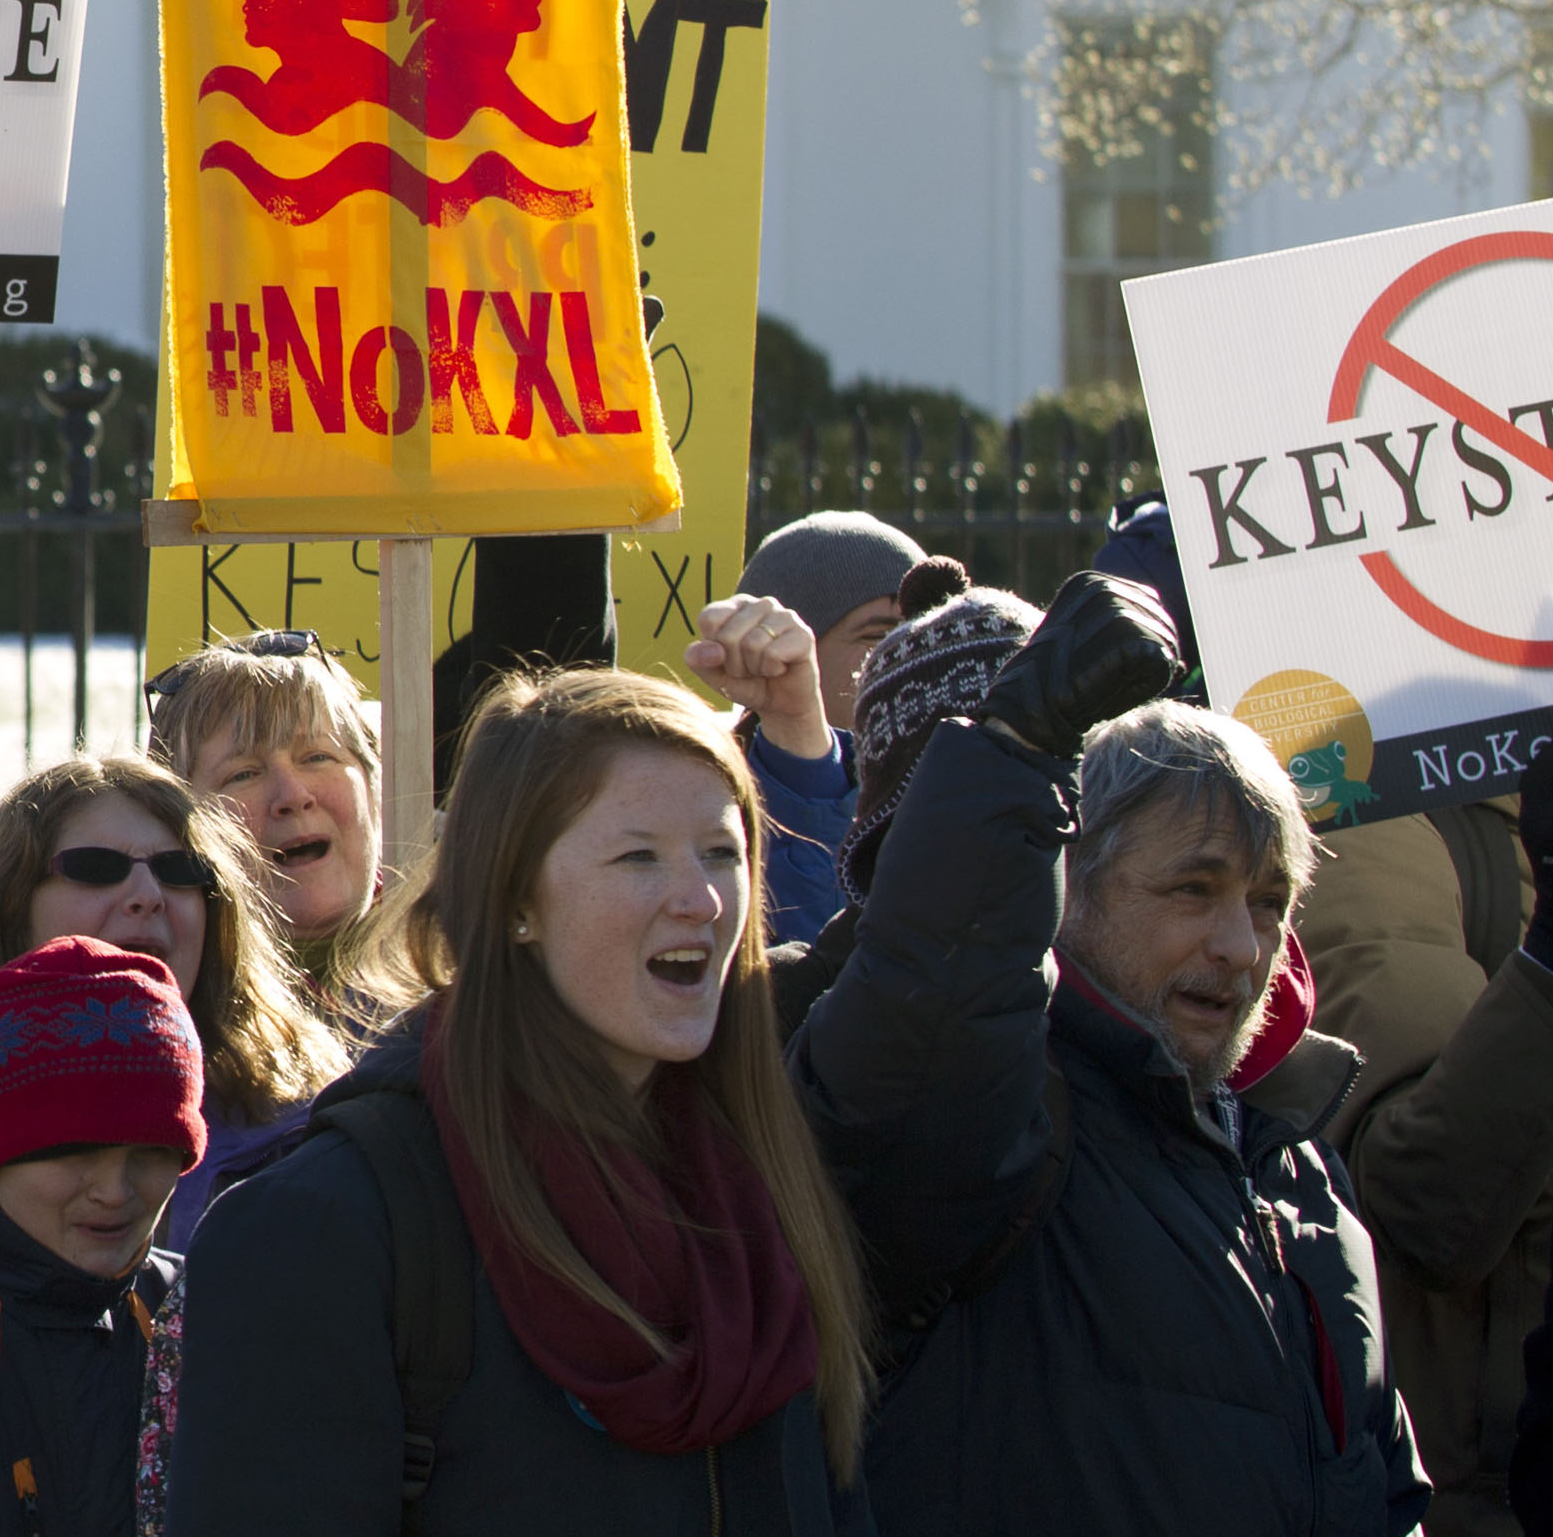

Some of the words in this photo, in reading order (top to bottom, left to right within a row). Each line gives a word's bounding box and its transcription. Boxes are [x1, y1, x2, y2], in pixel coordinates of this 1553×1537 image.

[206, 286, 641, 439] #NoKXL
[1249, 691, 1306, 712] CENTER
[1254, 704, 1335, 729] BIOLOGICAL
[1270, 720, 1338, 743] VERSITY
